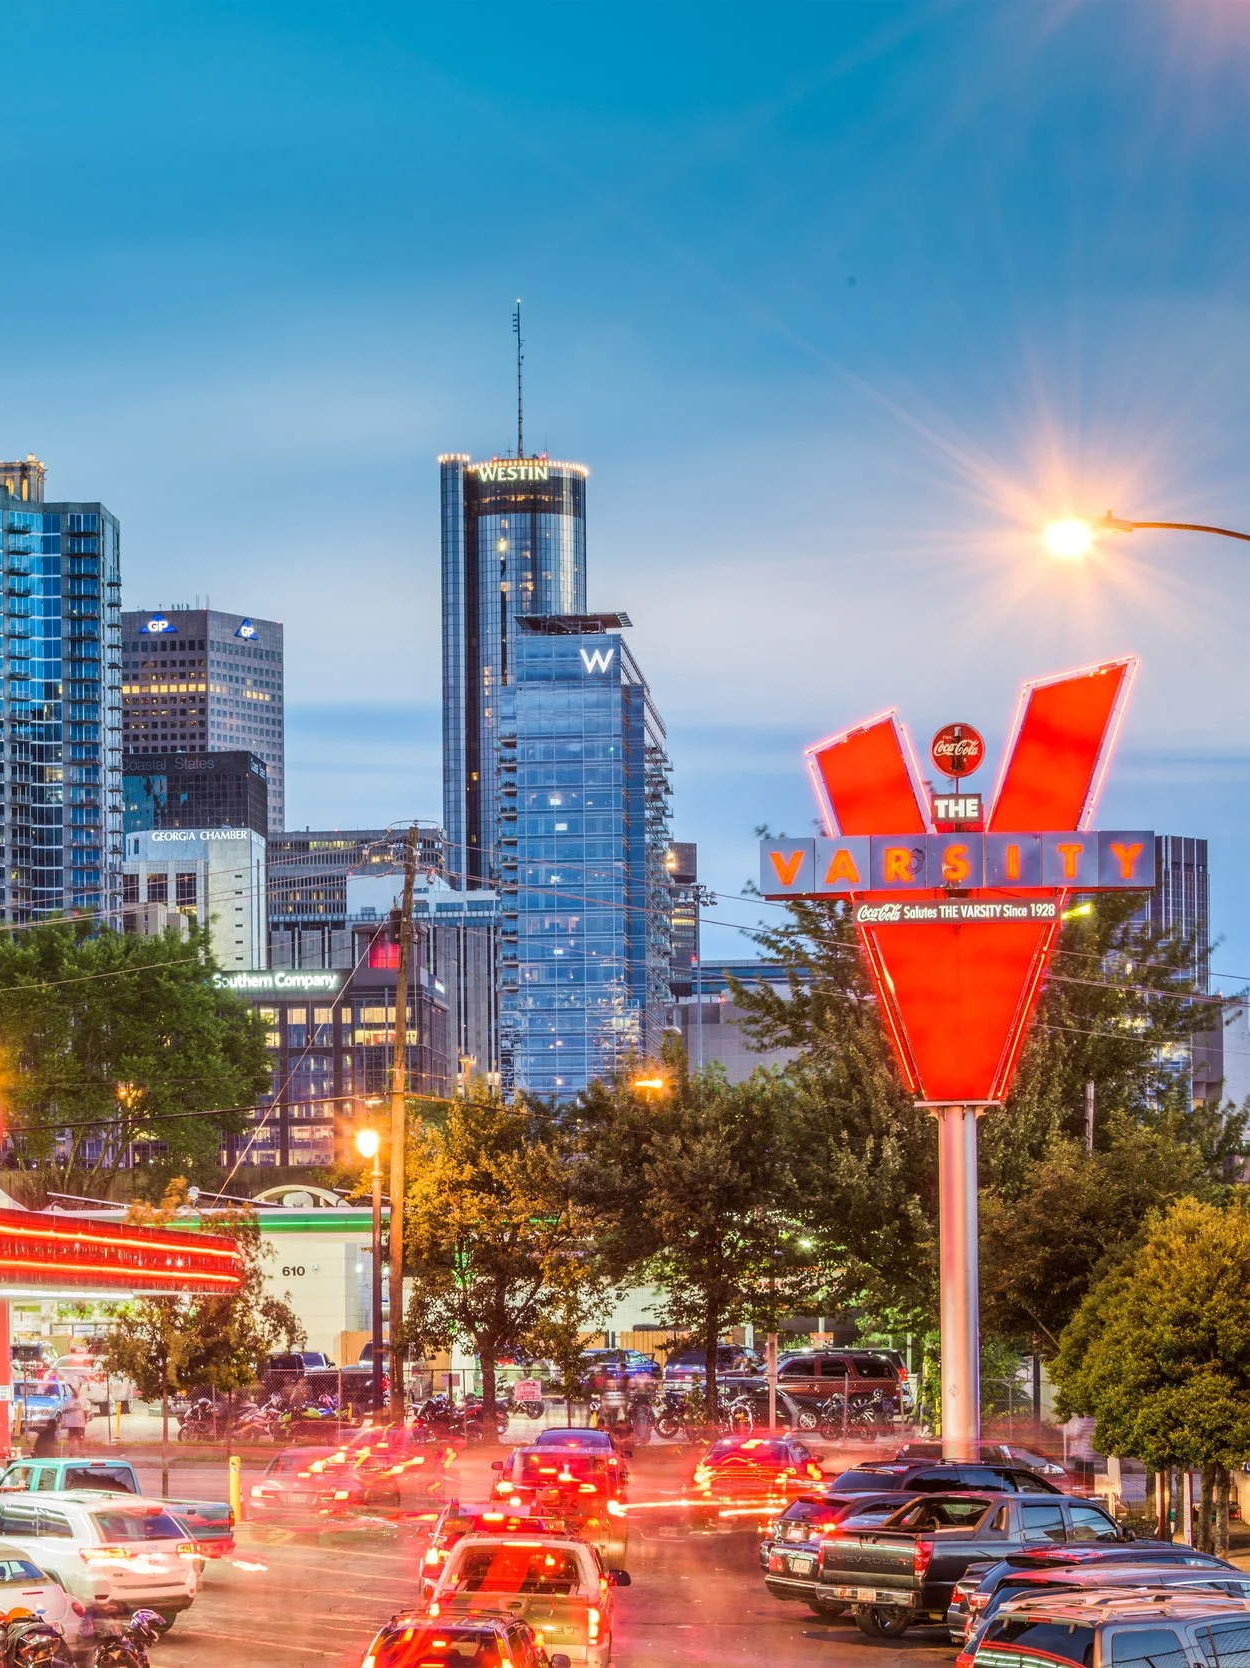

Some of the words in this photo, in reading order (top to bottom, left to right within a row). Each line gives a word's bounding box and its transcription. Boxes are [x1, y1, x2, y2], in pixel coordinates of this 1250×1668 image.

[478, 466, 548, 481] WESTIN
[148, 621, 169, 632] GP
[241, 626, 254, 637] GP
[580, 649, 614, 674] W
[122, 758, 167, 771] Coastal
[174, 757, 215, 770] States
[934, 798, 979, 818] THE
[151, 831, 196, 842] GEORGIA
[199, 830, 247, 841] CHAMBER
[769, 843, 1144, 886] VARSITY
[904, 905, 938, 919] Salutes
[939, 905, 959, 918] THE
[960, 904, 1002, 918] VARSITY
[1003, 903, 1028, 917] Since
[1030, 903, 1056, 917] 1928
[213, 973, 272, 989] Southern
[274, 972, 337, 990] Company
[282, 1266, 306, 1277] 610
